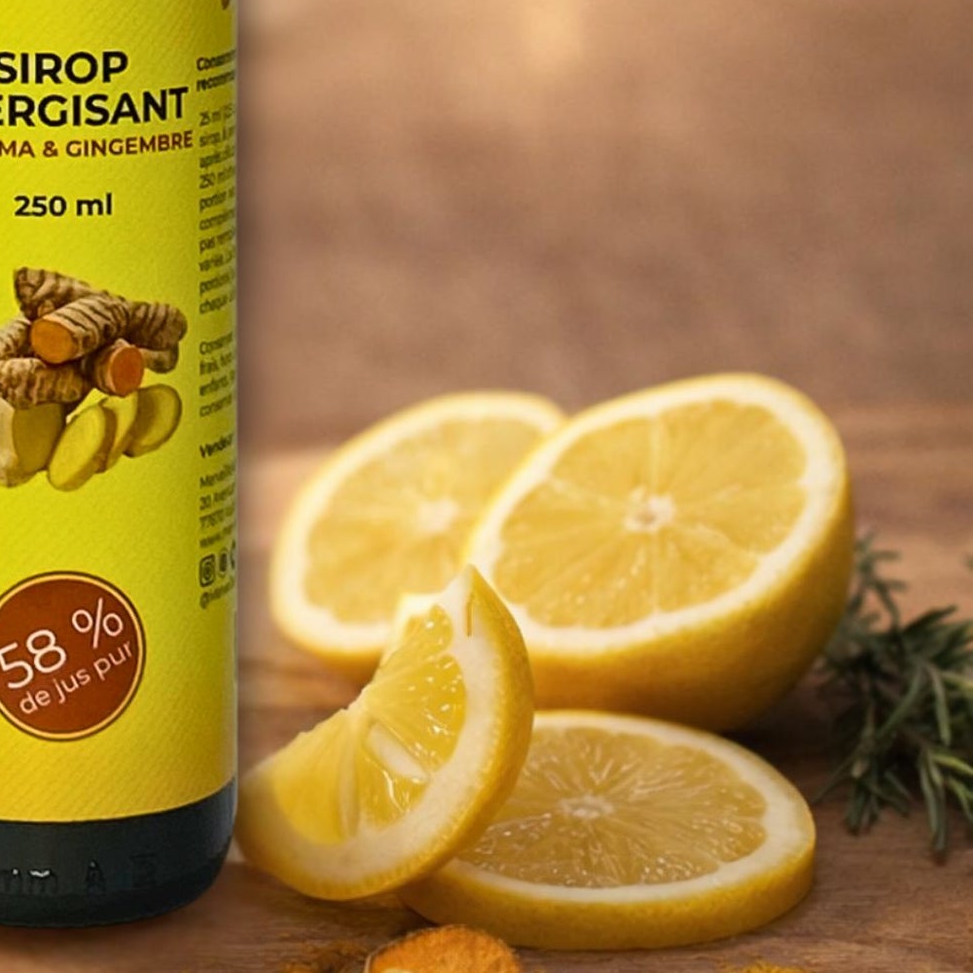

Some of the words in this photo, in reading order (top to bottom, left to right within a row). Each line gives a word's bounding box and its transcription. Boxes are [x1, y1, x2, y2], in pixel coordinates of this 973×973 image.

[42, 140, 59, 157] &
[66, 130, 194, 157] GINGEMBRE
[14, 195, 66, 217] 250
[77, 192, 112, 216] ml
[71, 597, 124, 649] %
[19, 691, 51, 714] de
[52, 668, 91, 704] jus
[93, 641, 132, 681] pur
